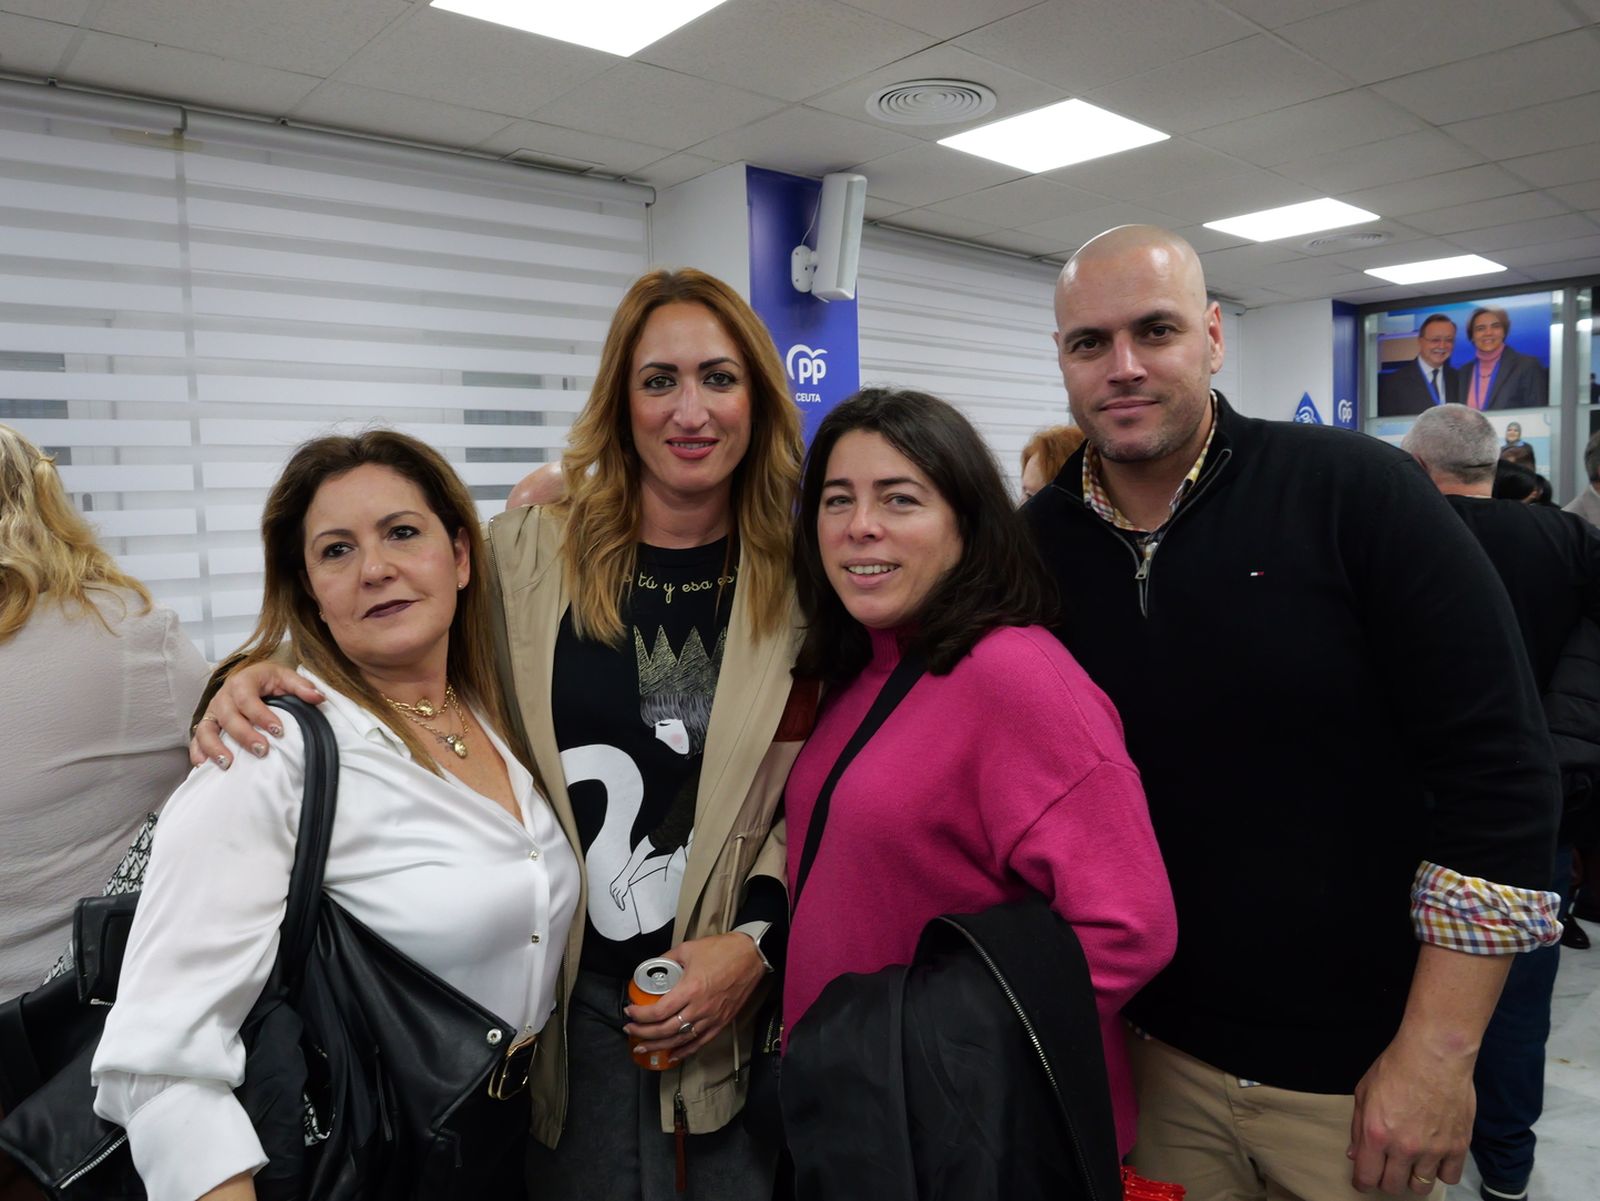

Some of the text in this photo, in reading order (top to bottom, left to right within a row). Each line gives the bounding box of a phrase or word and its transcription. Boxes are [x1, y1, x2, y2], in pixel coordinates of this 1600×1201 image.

[795, 392, 821, 402] CEUTA
[663, 582, 675, 604] y
[682, 579, 713, 592] esa
